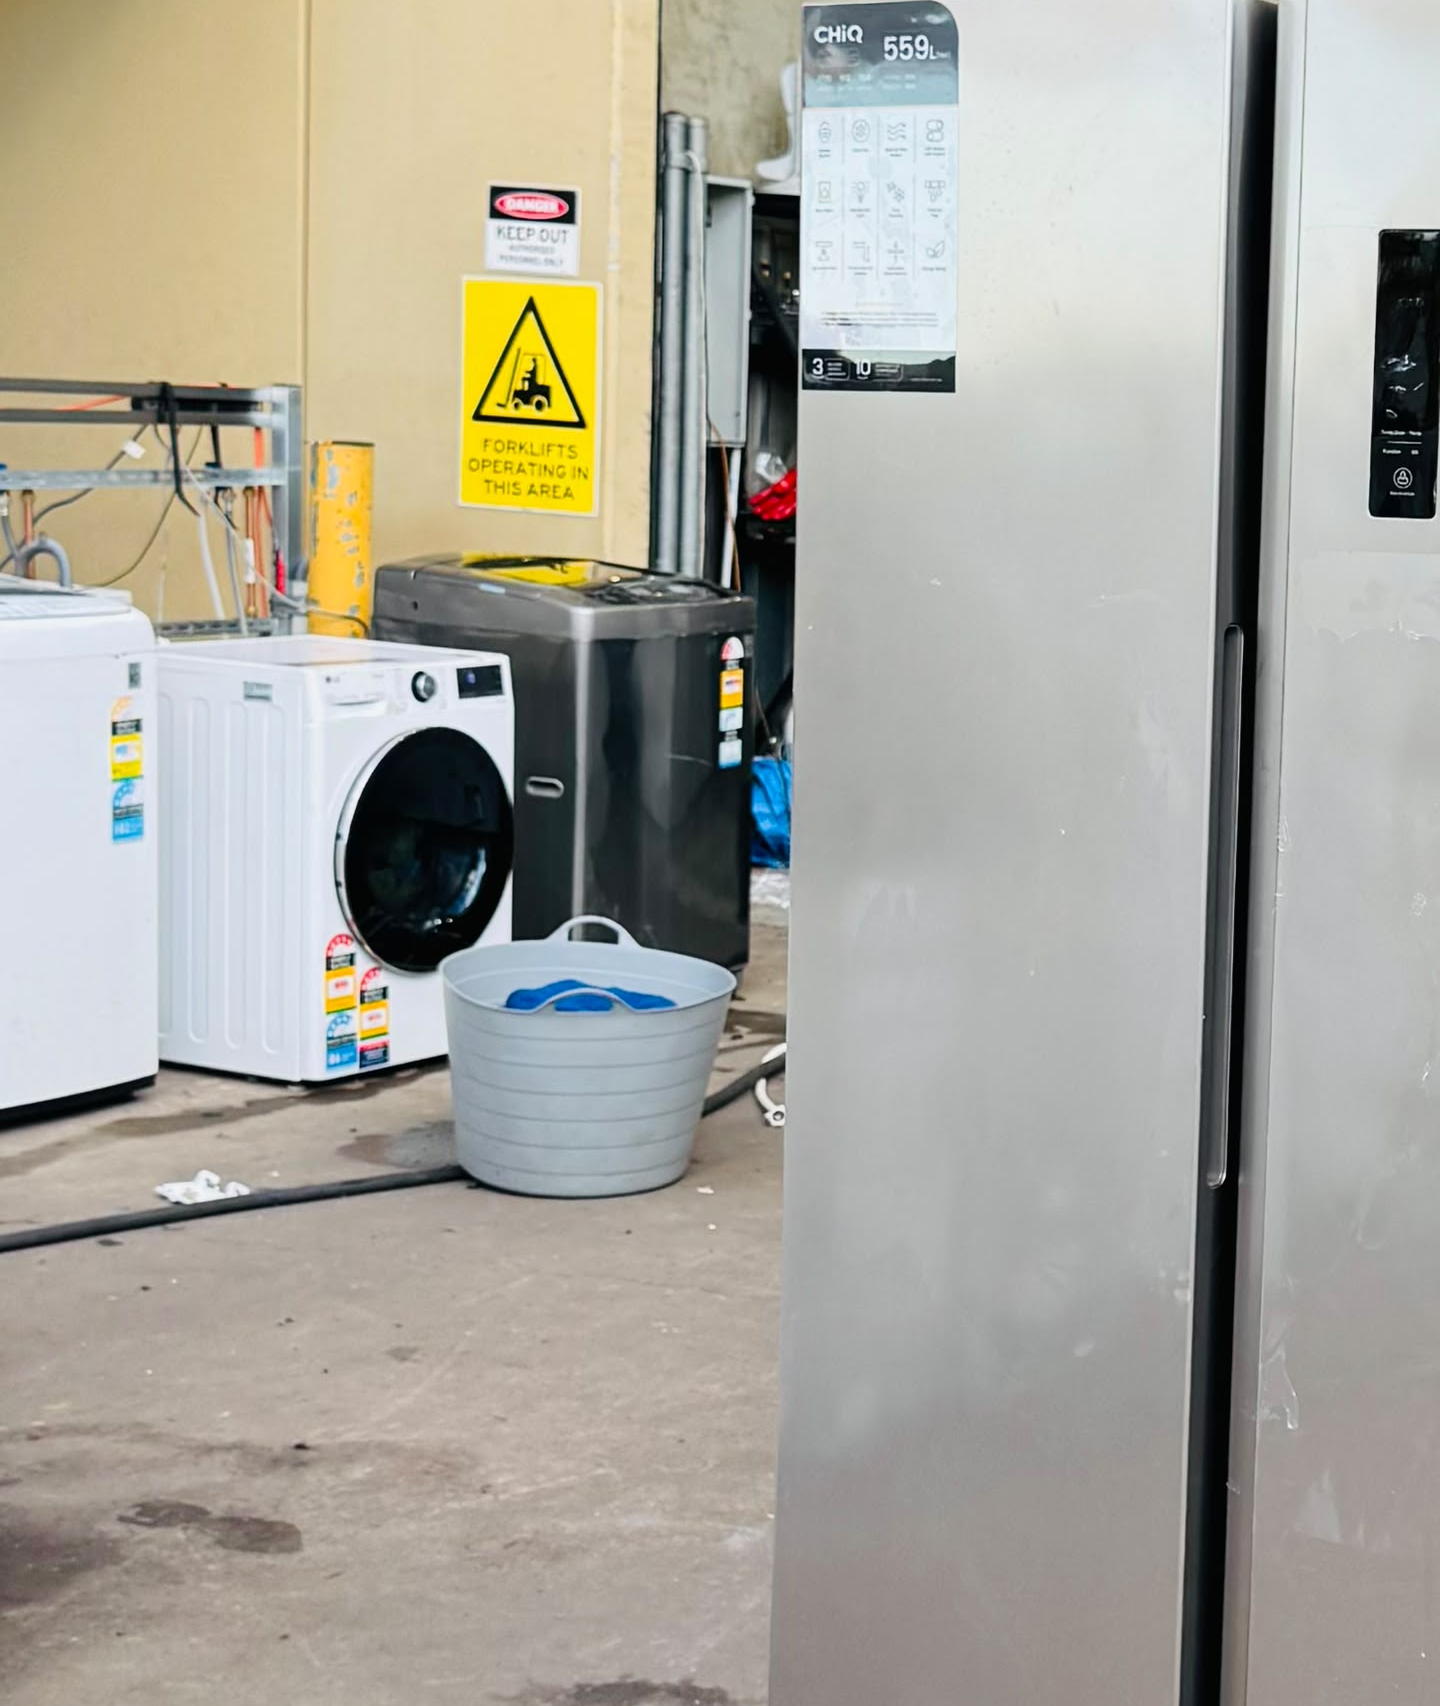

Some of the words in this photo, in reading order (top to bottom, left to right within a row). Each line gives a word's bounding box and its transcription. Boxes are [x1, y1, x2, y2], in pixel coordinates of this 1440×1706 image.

[813, 24, 863, 44] CHiQ
[496, 226, 536, 241] KEEP
[540, 229, 569, 244] OUT
[812, 357, 824, 375] 3
[855, 358, 872, 376] 10
[483, 438, 578, 460] FORKLIFTS
[468, 458, 567, 479] OPERATING
[572, 466, 589, 480] IN
[483, 479, 522, 496] THIS
[527, 483, 575, 500] AREA
